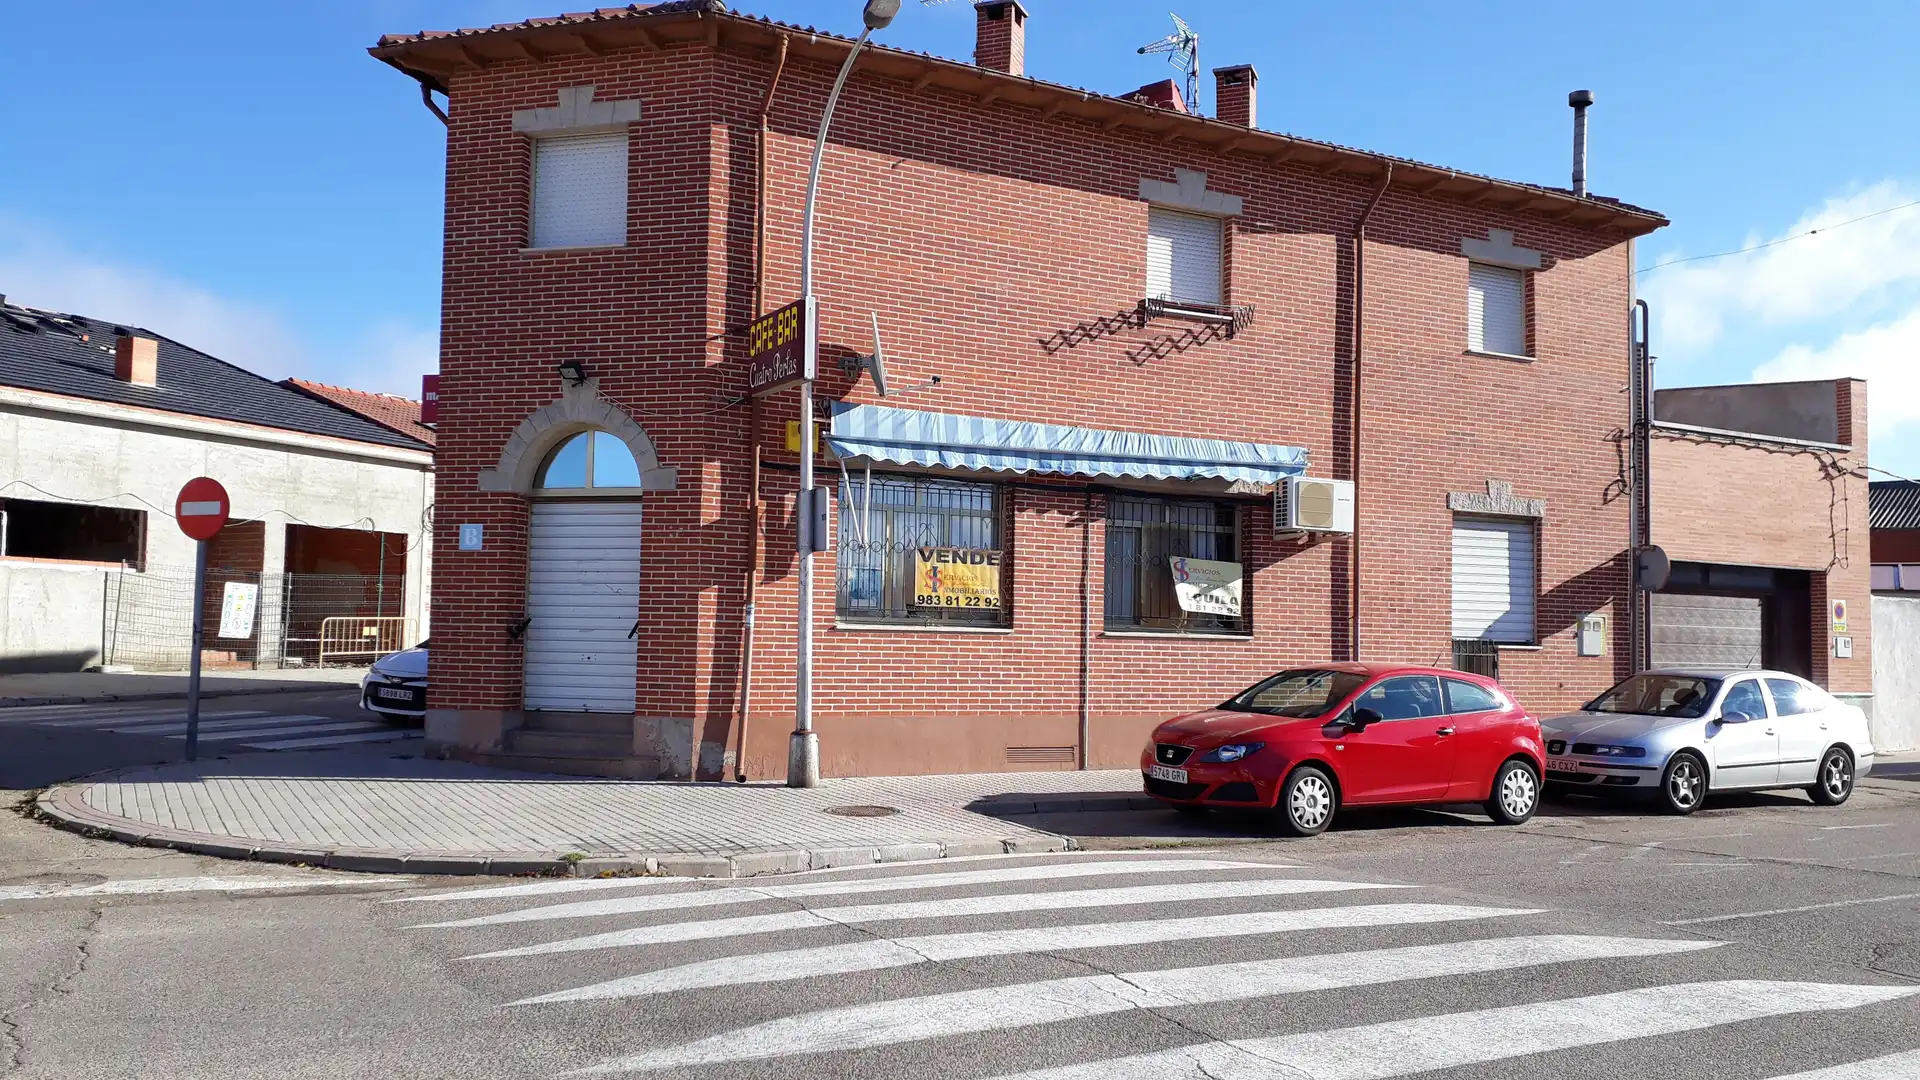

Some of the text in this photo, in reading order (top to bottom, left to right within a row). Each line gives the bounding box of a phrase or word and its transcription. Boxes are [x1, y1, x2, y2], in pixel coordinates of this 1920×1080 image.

[750, 306, 798, 357] CAFE-BAR
[750, 362, 773, 388] Cuatro
[464, 528, 477, 545] B
[918, 548, 1001, 566] VENDE
[917, 594, 1000, 608] 983 81 22 92
[1185, 591, 1239, 606] LQUILA
[1154, 766, 1186, 782] 5748 GRV
[1559, 761, 1575, 772] CXZ
